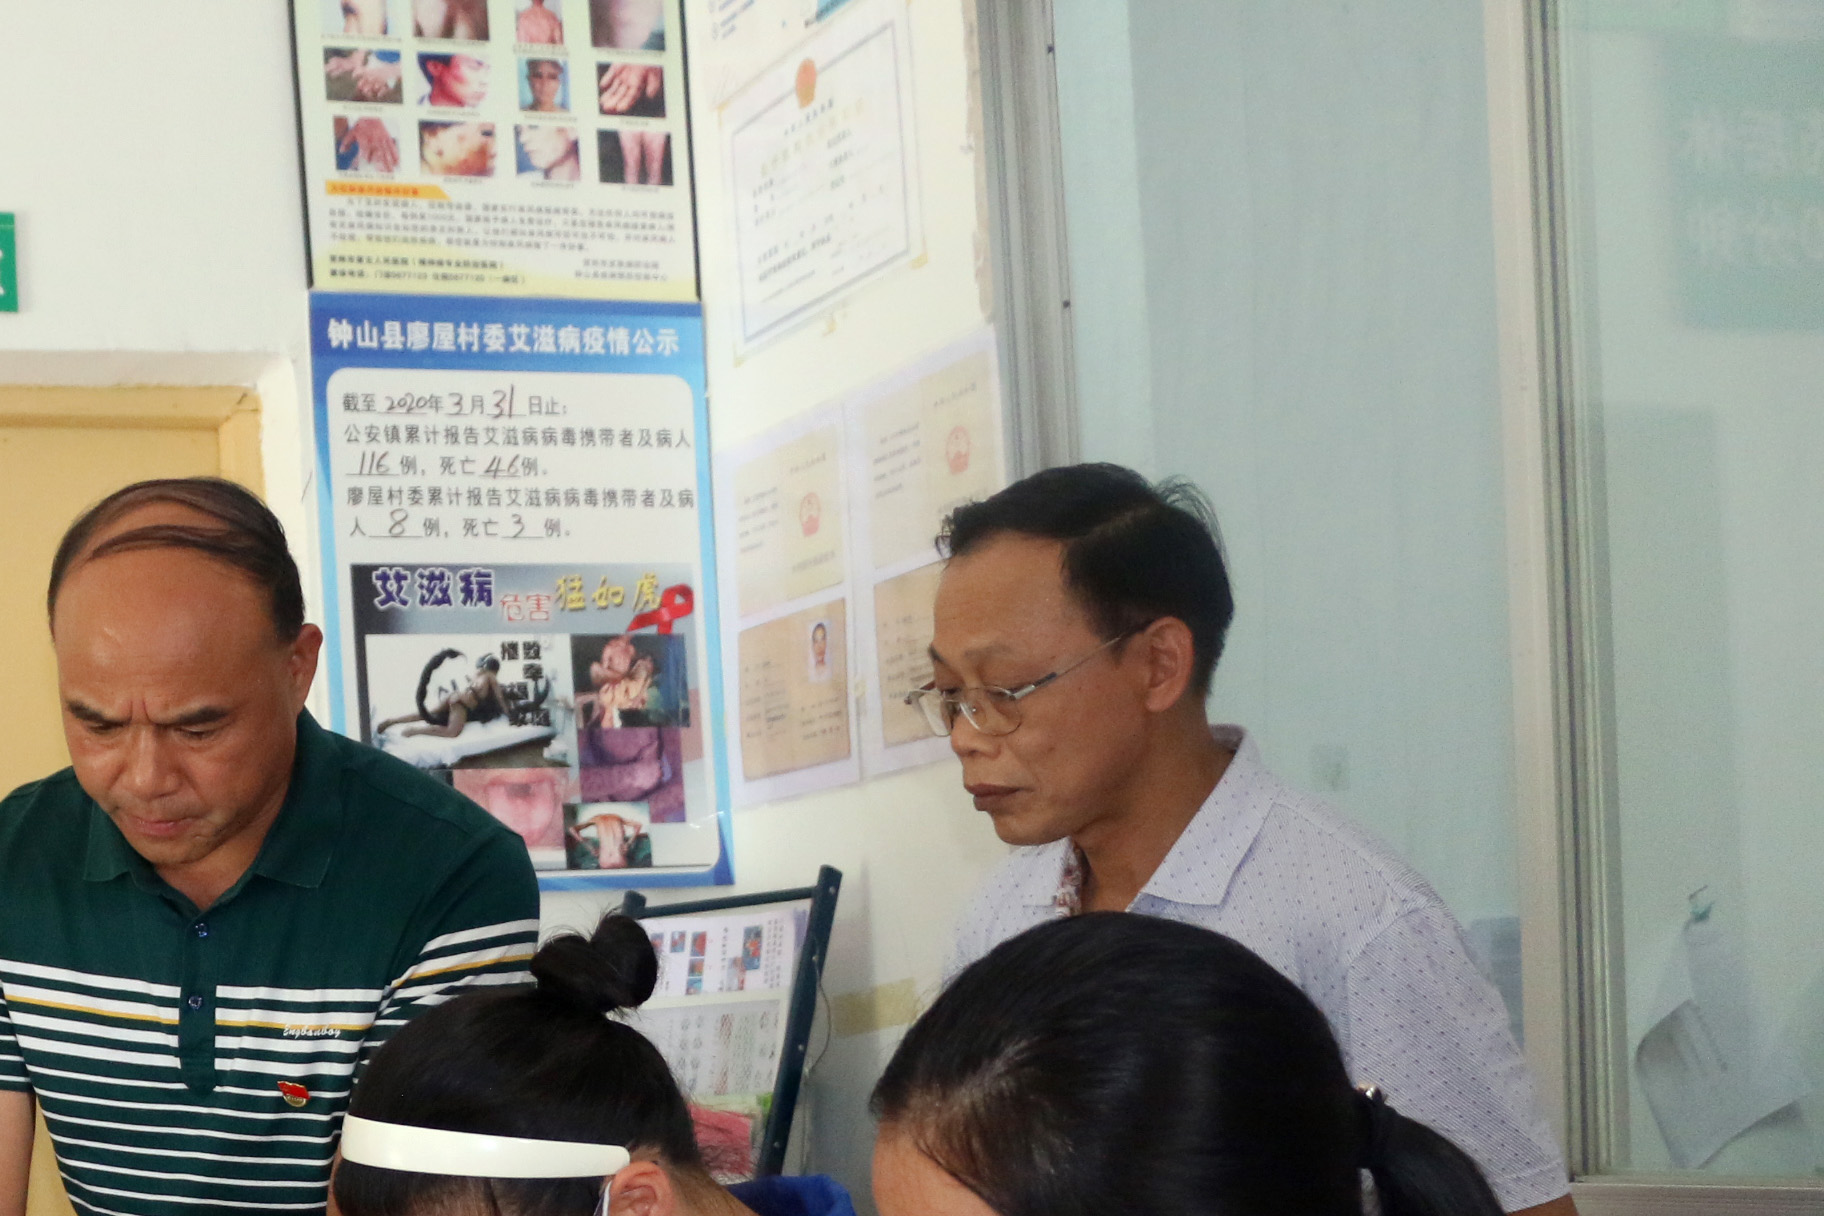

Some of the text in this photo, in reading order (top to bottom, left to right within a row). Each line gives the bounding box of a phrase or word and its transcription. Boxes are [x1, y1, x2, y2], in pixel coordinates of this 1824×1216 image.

[326, 318, 681, 357] 钟山县廖屋村委艾滋病疫情公示
[344, 423, 692, 450] 公安镇累计报告艾滋病病毒携带者及病人
[347, 485, 695, 511] 廖屋村委累计报告艾滋病病毒携带者及病
[372, 567, 495, 610] 艾滋病
[555, 571, 663, 612] 猛如虎
